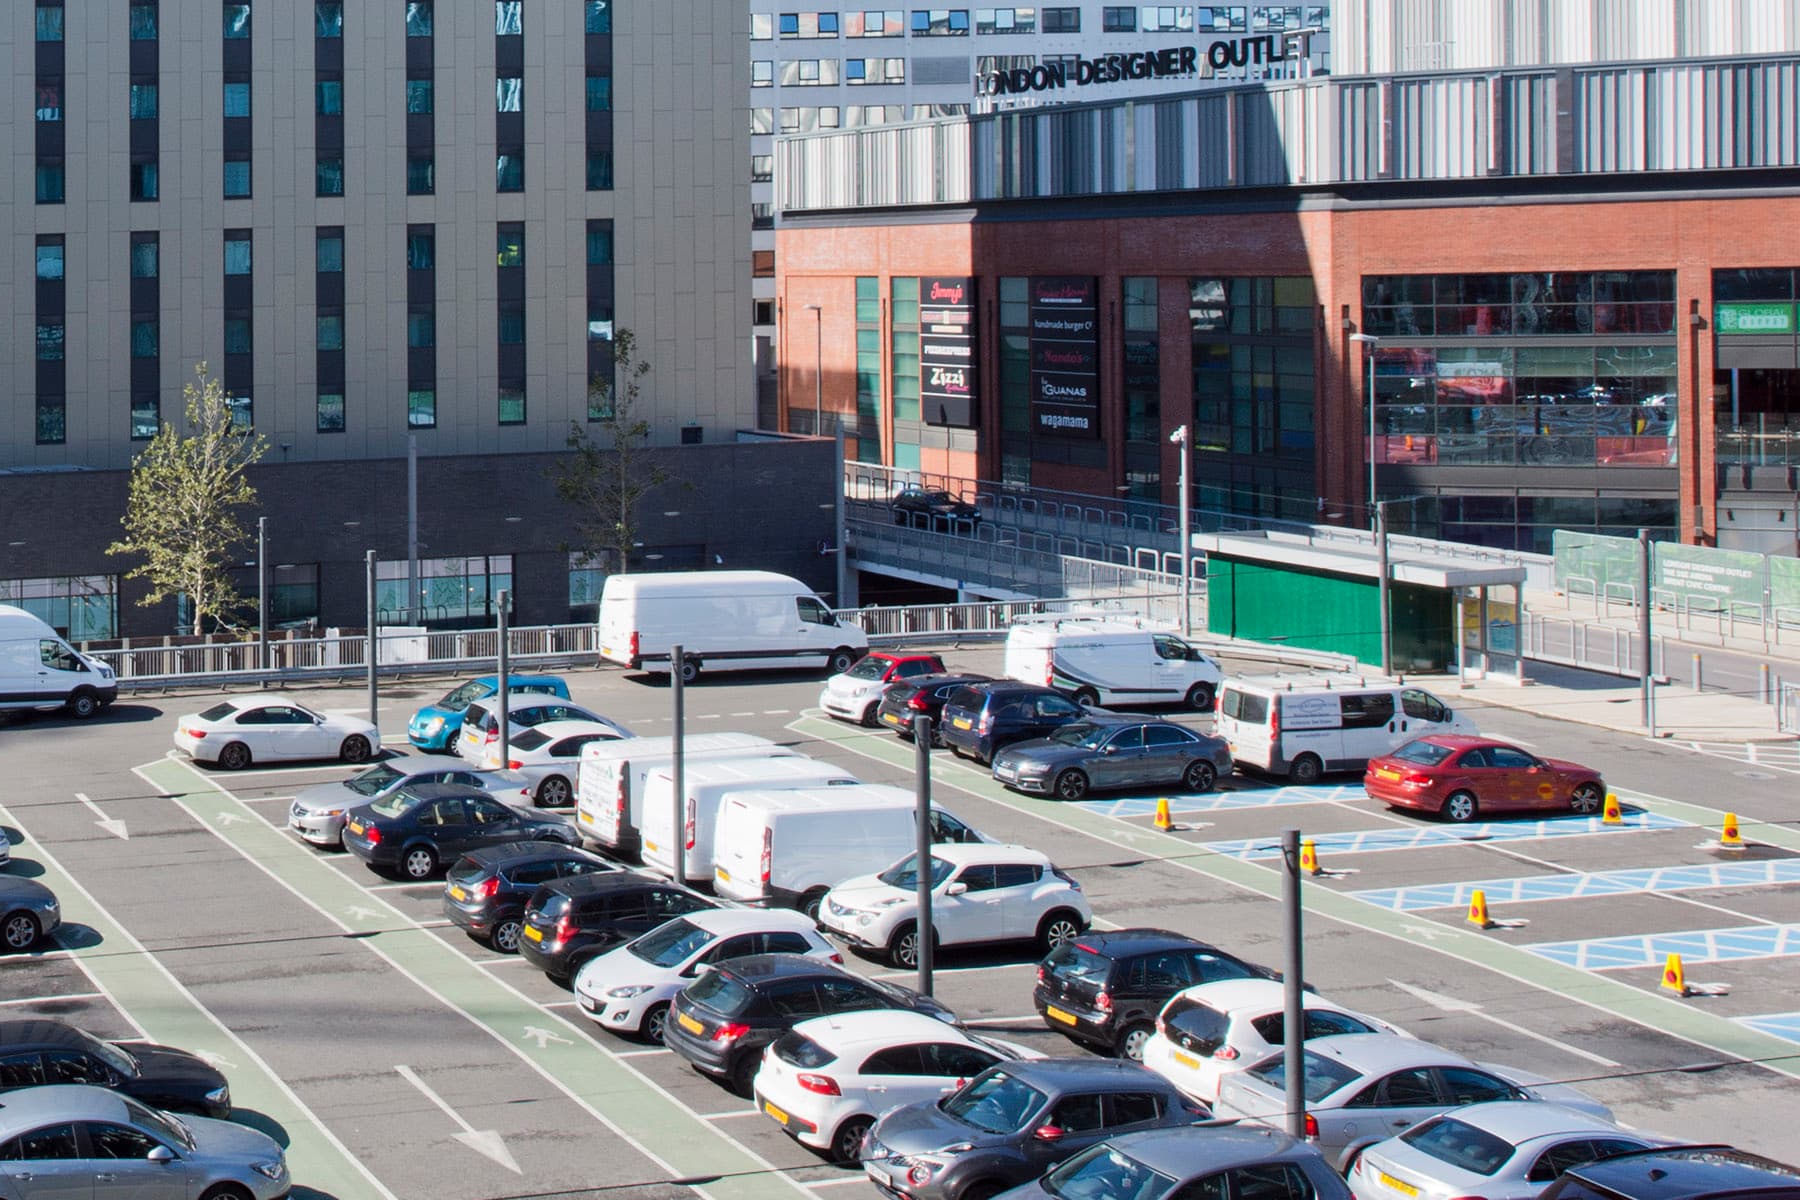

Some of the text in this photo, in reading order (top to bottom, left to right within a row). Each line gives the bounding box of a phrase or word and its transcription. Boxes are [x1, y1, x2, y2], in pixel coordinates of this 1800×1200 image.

[975, 29, 1319, 97] LONDON DESIGNER OUTLET
[931, 368, 965, 386] Zizzi
[1040, 414, 1089, 429] wagamama
